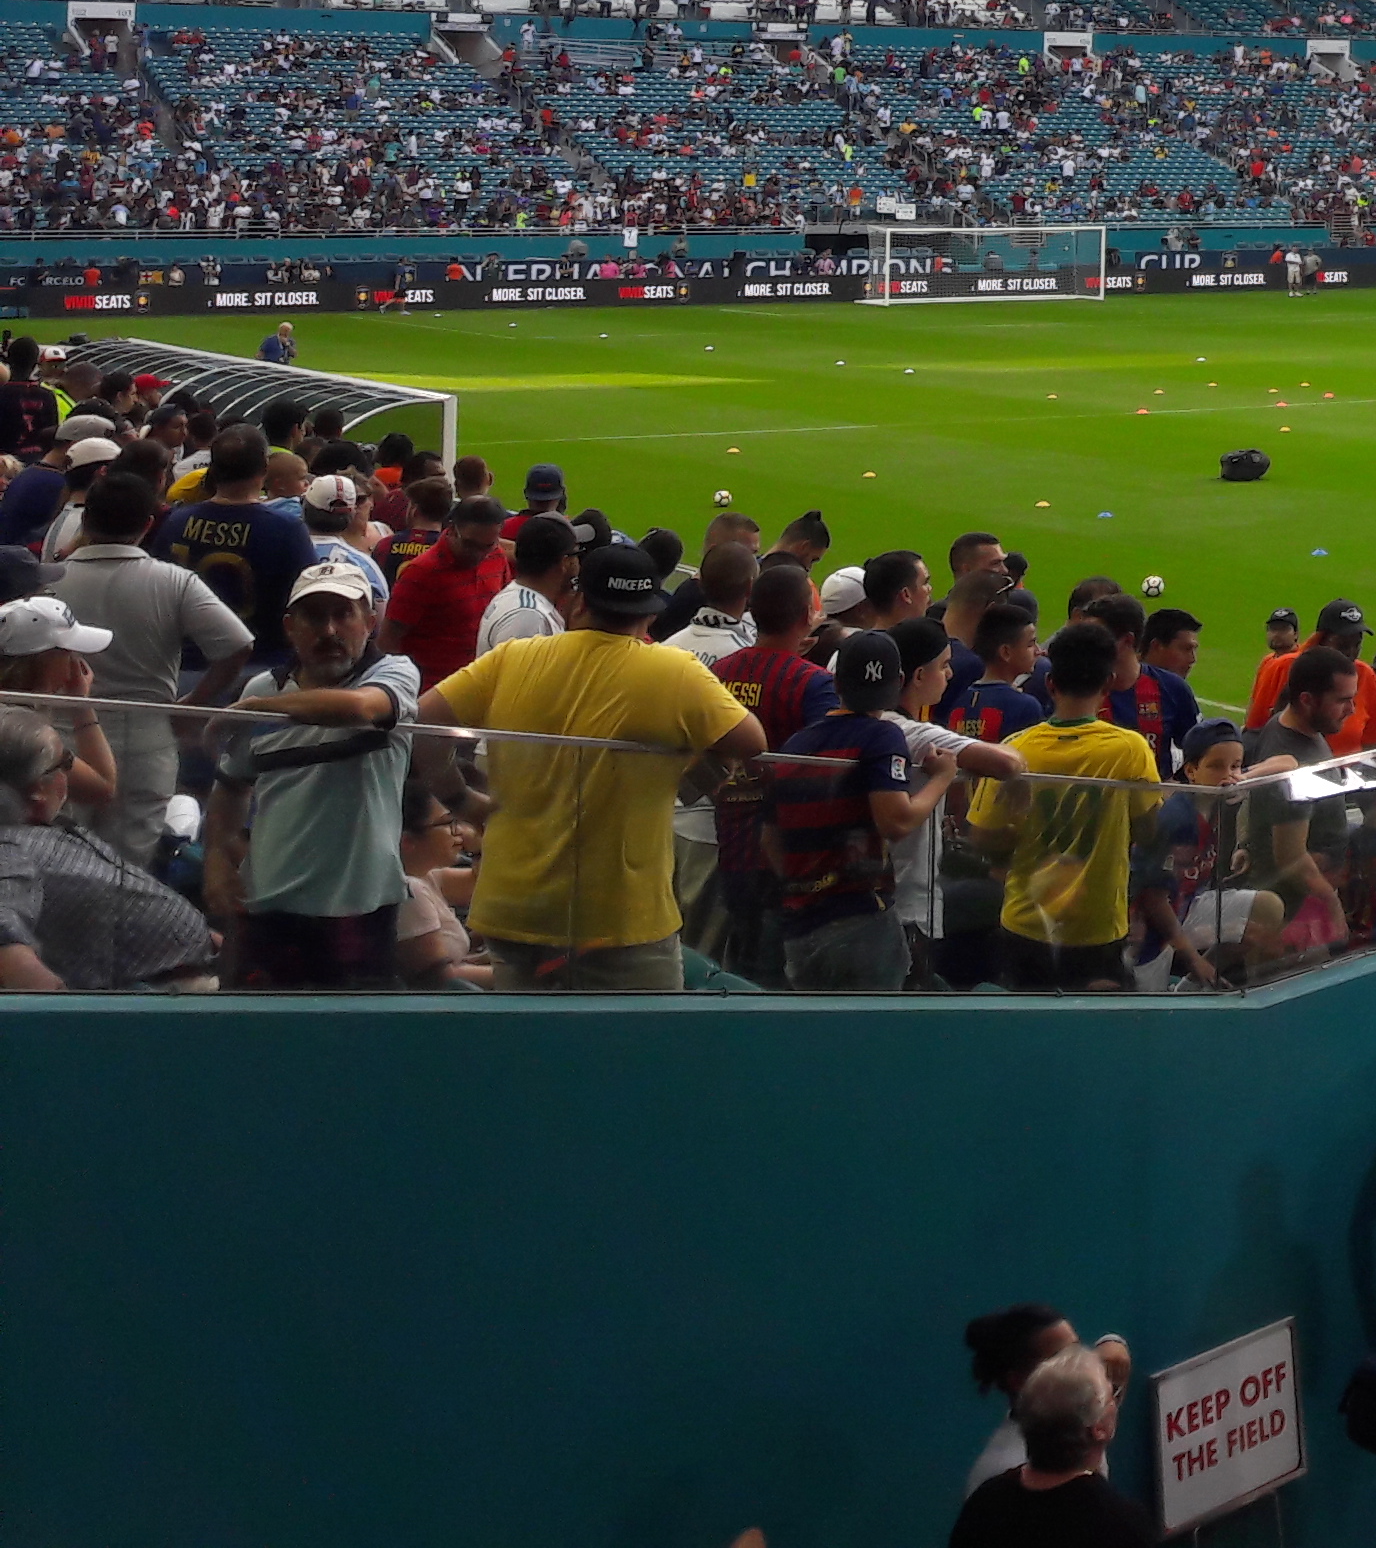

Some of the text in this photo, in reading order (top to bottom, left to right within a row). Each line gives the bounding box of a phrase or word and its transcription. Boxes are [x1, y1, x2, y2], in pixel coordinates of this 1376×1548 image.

[978, 278, 1058, 291] MORE. SIT CLOSER.
[1106, 276, 1131, 288] SEATS
[1192, 273, 1265, 286] MORE. SIT CLOSER.
[1324, 272, 1348, 283] SEATS
[492, 286, 586, 302] MORE. SIT CLOSER.
[644, 286, 674, 298] SEATS
[744, 282, 831, 297] MORE. SIT CLOSER.
[900, 281, 928, 293] SEATS
[95, 295, 131, 309] SEATS
[216, 290, 320, 307] MORE. SIT CLOSER.
[182, 516, 250, 546] MESSI
[608, 577, 635, 590] NIKE
[865, 660, 882, 682] NY
[1166, 1361, 1287, 1442] KEEP OFF
[1172, 1408, 1286, 1481] THE FIELD
